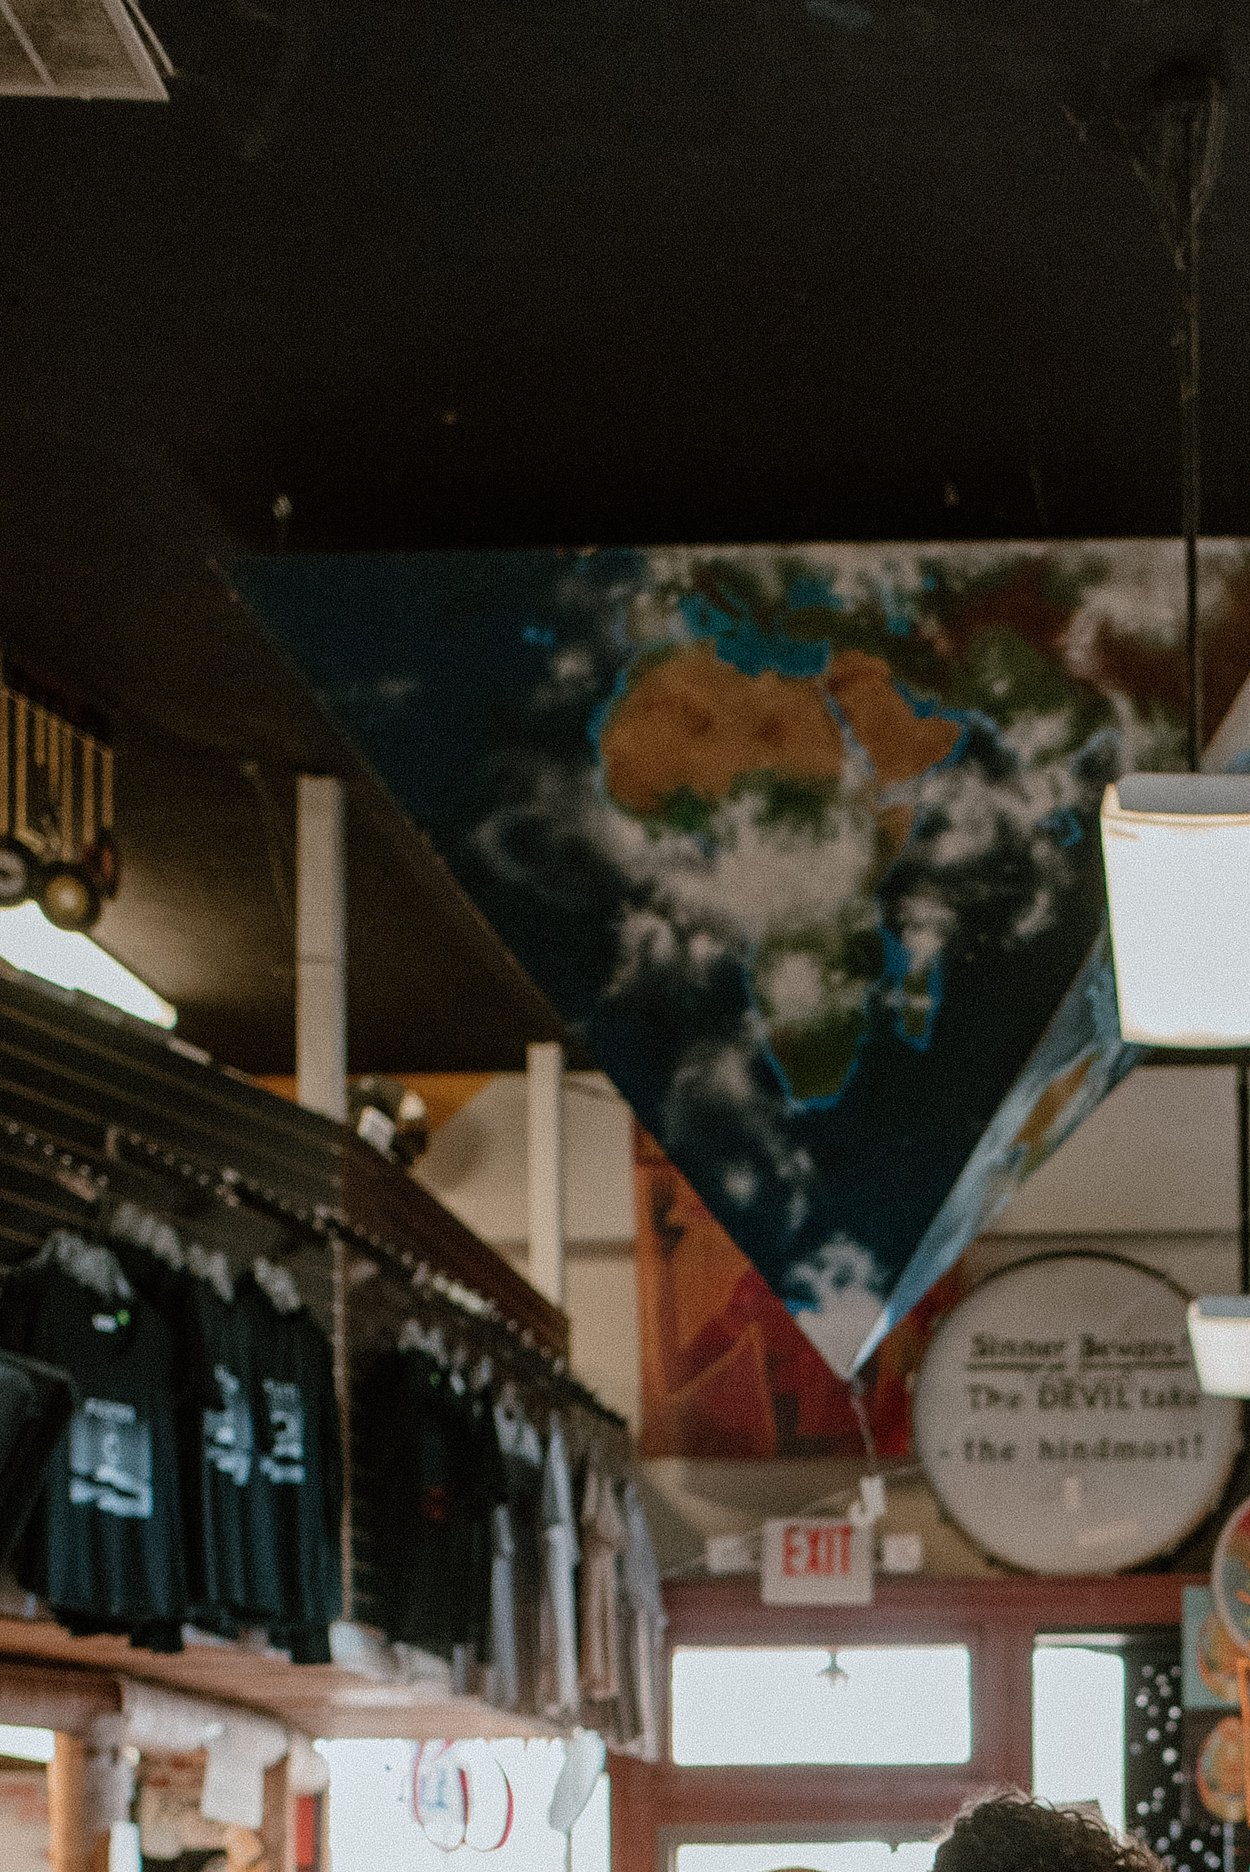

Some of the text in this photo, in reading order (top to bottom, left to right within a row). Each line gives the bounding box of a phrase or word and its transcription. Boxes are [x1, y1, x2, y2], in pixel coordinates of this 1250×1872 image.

[970, 1332, 1067, 1358] Sinner
[967, 1382, 1022, 1410] The
[1038, 1379, 1132, 1410] DEVIL
[963, 1437, 1016, 1462] the
[782, 1523, 854, 1577] EXIT
